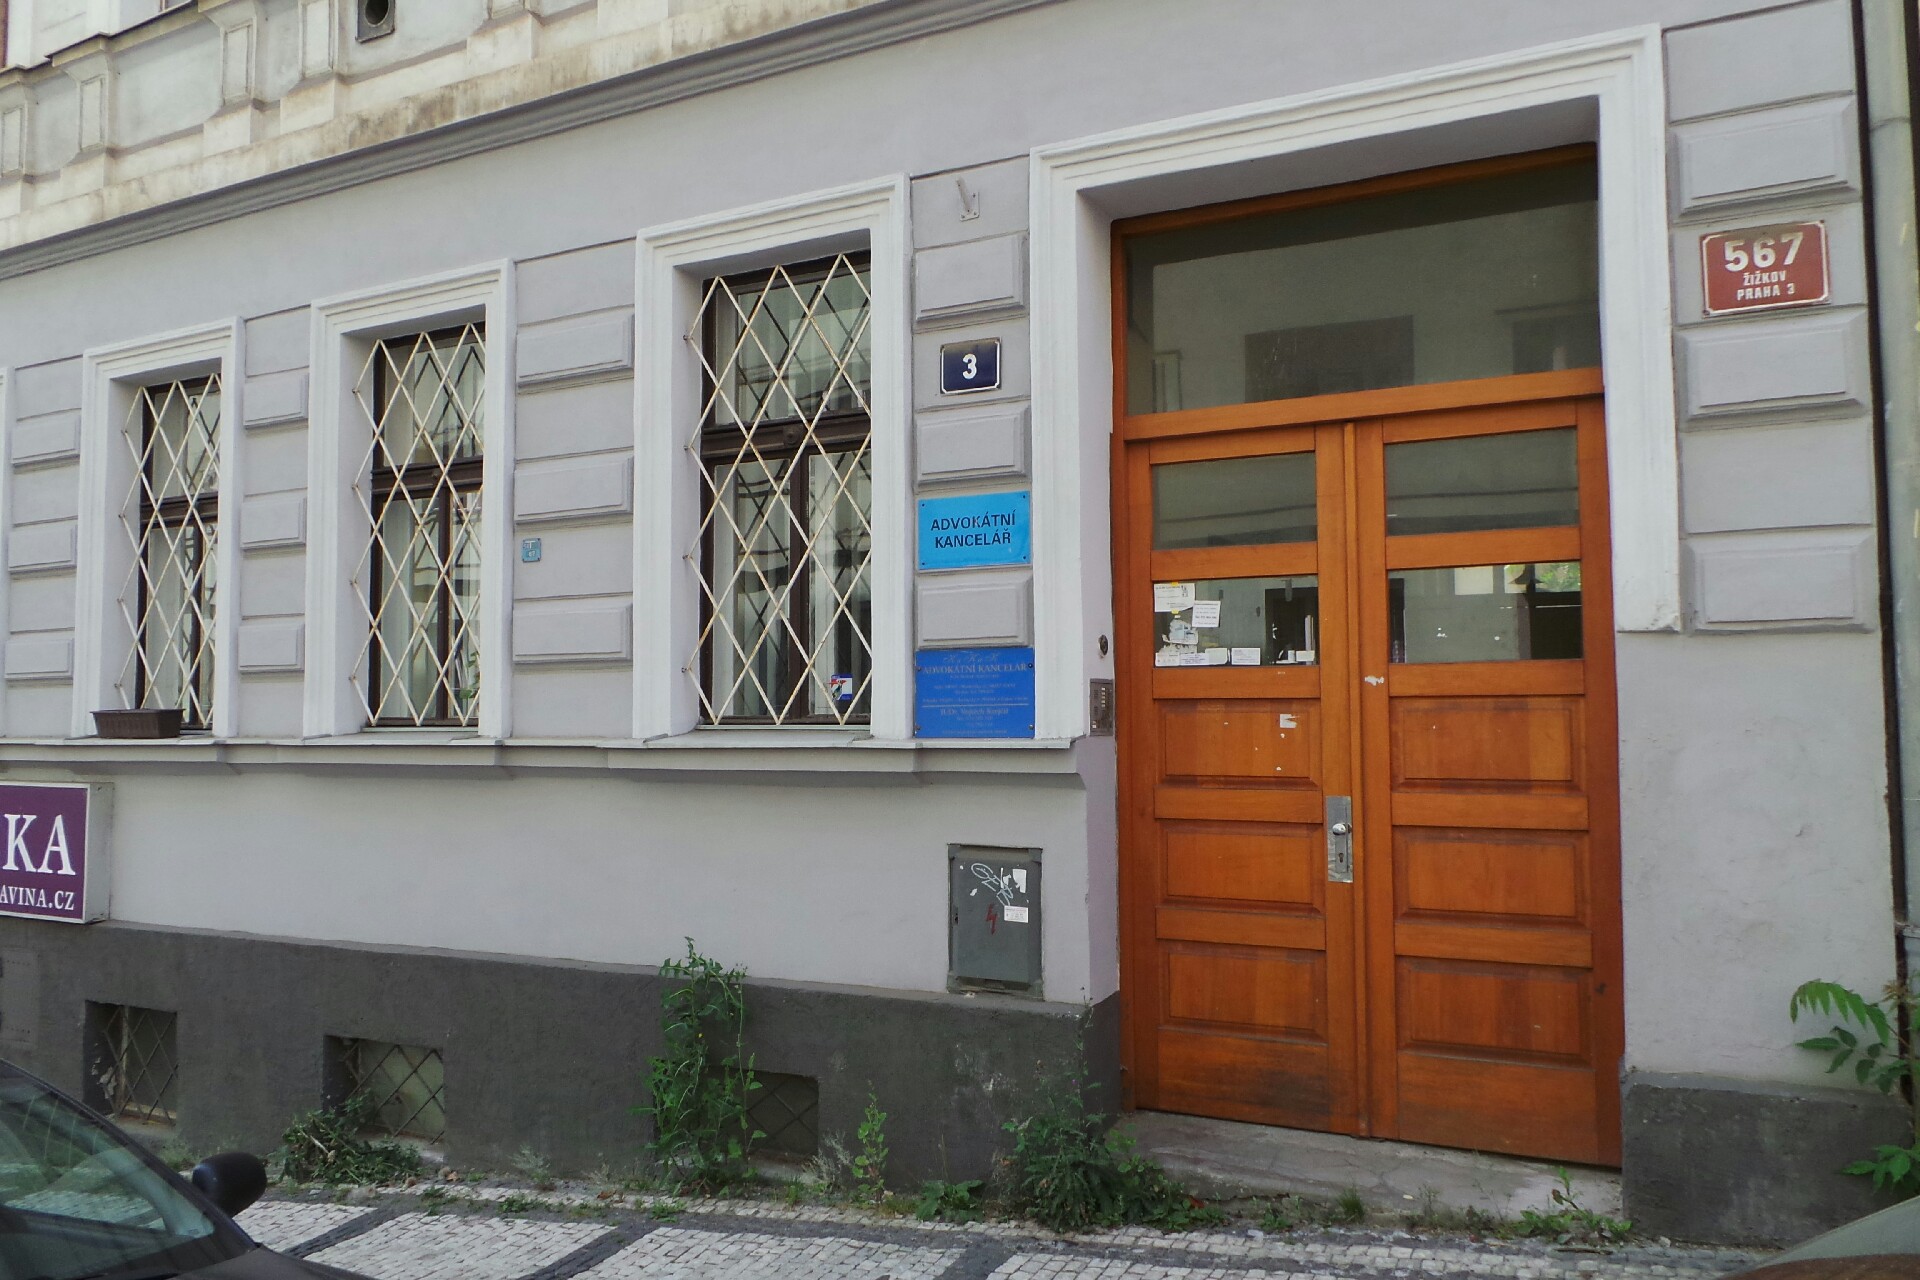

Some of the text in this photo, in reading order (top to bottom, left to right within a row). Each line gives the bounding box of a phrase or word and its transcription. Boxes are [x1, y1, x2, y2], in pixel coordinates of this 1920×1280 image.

[1724, 232, 1803, 271] 567
[1743, 270, 1786, 286] ŽIŽKOV
[1737, 283, 1796, 300] PRAHA 3
[962, 353, 977, 380] 3
[930, 509, 1017, 531] ADVOKÁTNÍ
[934, 527, 1012, 549] KANCELÁŘ
[2, 813, 76, 876] KA
